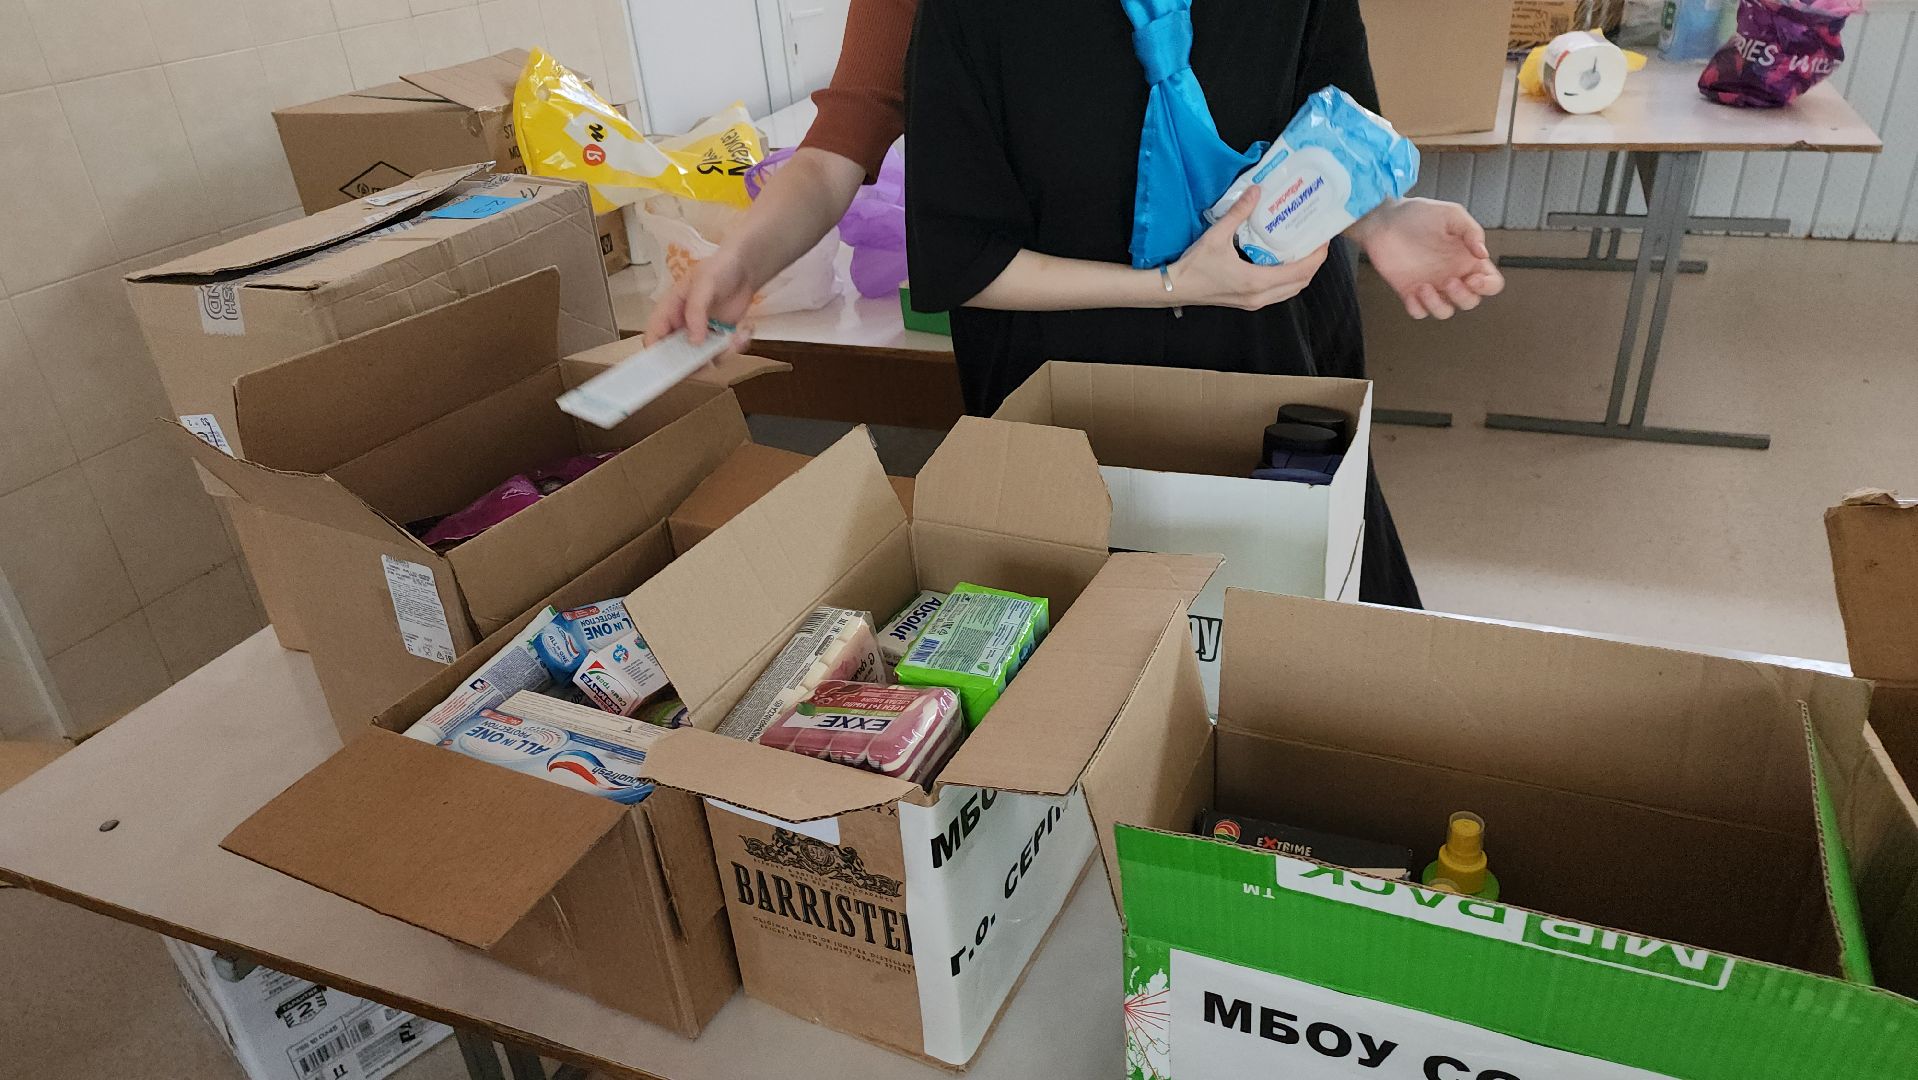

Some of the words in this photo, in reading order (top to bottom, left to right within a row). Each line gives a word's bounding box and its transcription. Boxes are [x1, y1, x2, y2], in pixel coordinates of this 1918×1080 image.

[580, 611, 621, 628] PROTECTION
[613, 622, 625, 631] IN
[889, 596, 942, 641] Absolut
[584, 623, 613, 640] ONE
[882, 704, 906, 712] КРЕМ
[480, 720, 532, 739] PROTECTION
[814, 715, 892, 731] EXXE
[465, 726, 505, 743] ONE
[504, 737, 517, 747] IN
[514, 740, 551, 756] ALL
[1004, 804, 1062, 899] СЕРП
[1256, 836, 1313, 857] EXTRIME
[1242, 883, 1276, 900] TM
[753, 916, 790, 931] ORIGINAL
[793, 928, 818, 940] BLEND
[834, 940, 867, 954] JUNIPER
[788, 933, 803, 941] AND
[807, 938, 822, 947] THE
[855, 953, 881, 965] GRAIN
[296, 1001, 314, 1018] 2
[1203, 990, 1399, 1068] МБОУ
